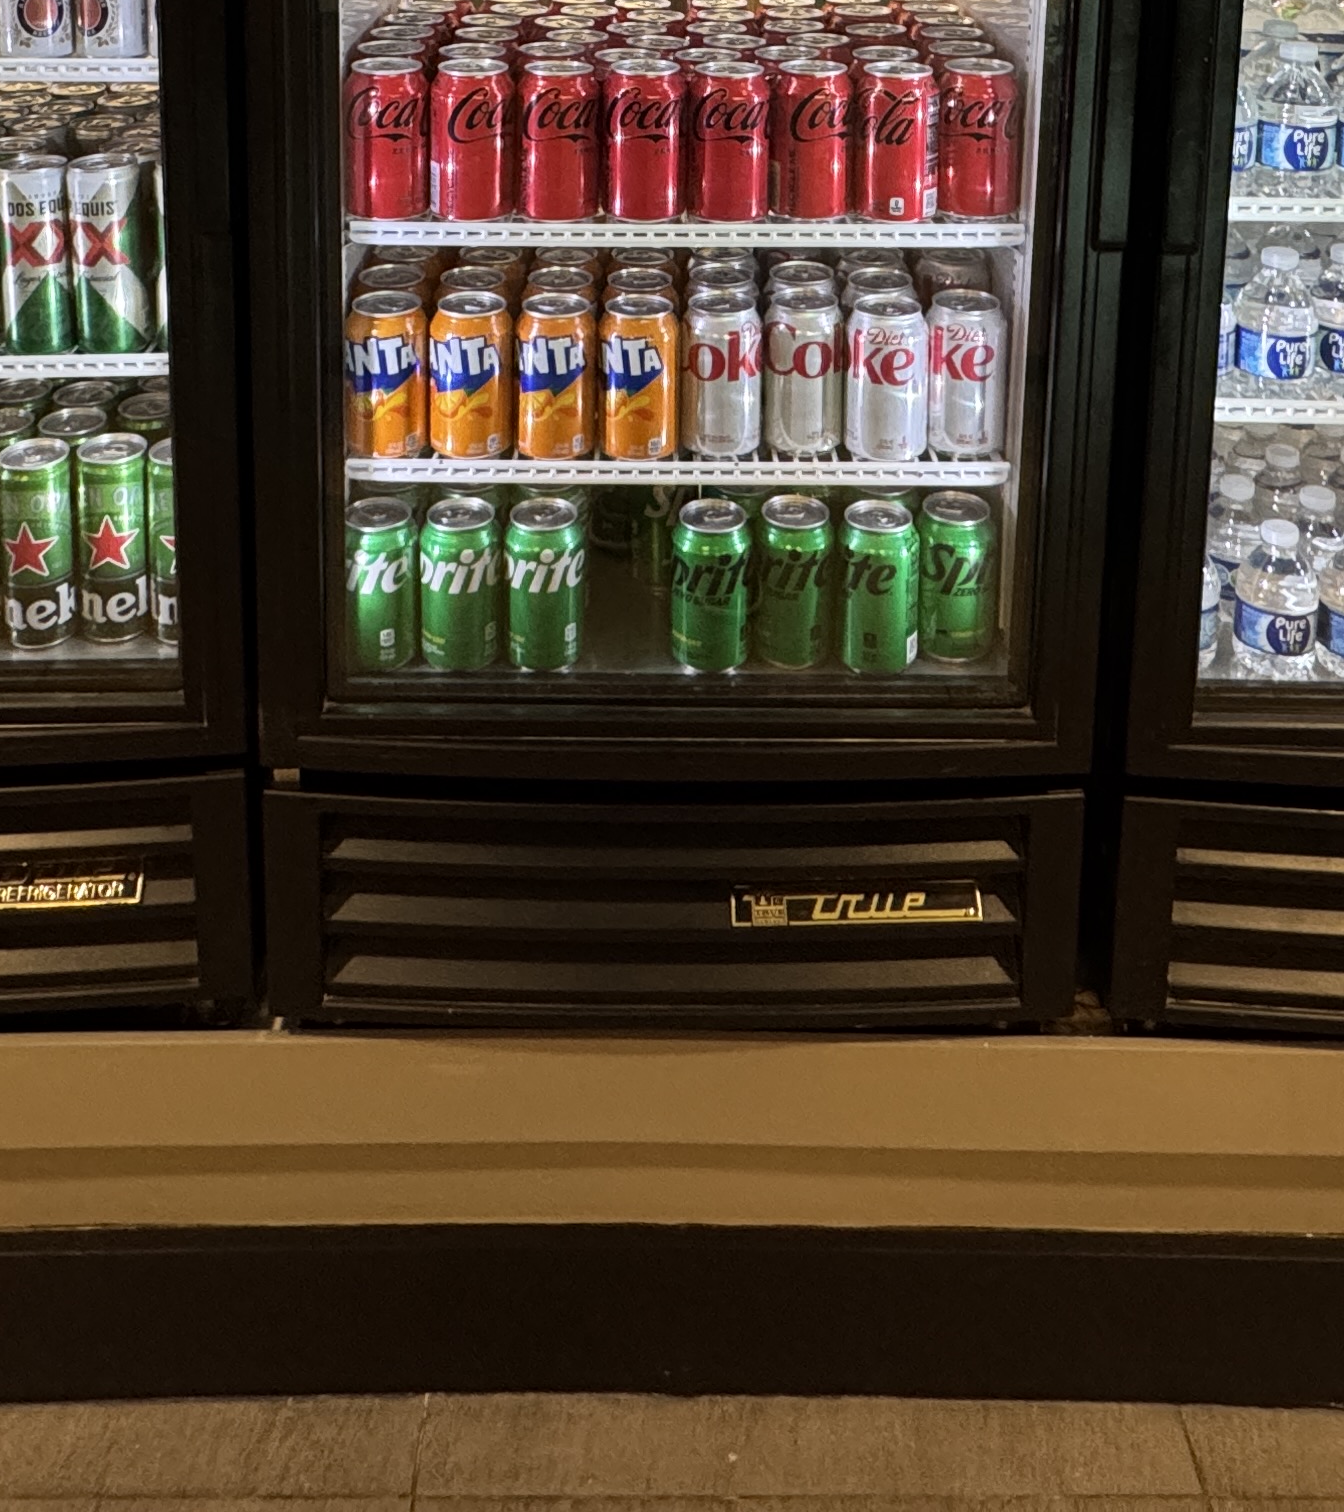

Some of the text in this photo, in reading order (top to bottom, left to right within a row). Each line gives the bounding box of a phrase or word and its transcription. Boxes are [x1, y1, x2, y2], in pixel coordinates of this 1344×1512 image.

[1293, 129, 1325, 146] Pure
[1296, 143, 1321, 160] Life
[8, 202, 35, 217] DOS
[867, 326, 905, 346] Diet
[1275, 340, 1307, 355] Pure
[1279, 352, 1304, 369] Life
[1275, 617, 1307, 632] Pure
[1278, 629, 1304, 646] Life
[801, 892, 967, 920] true
